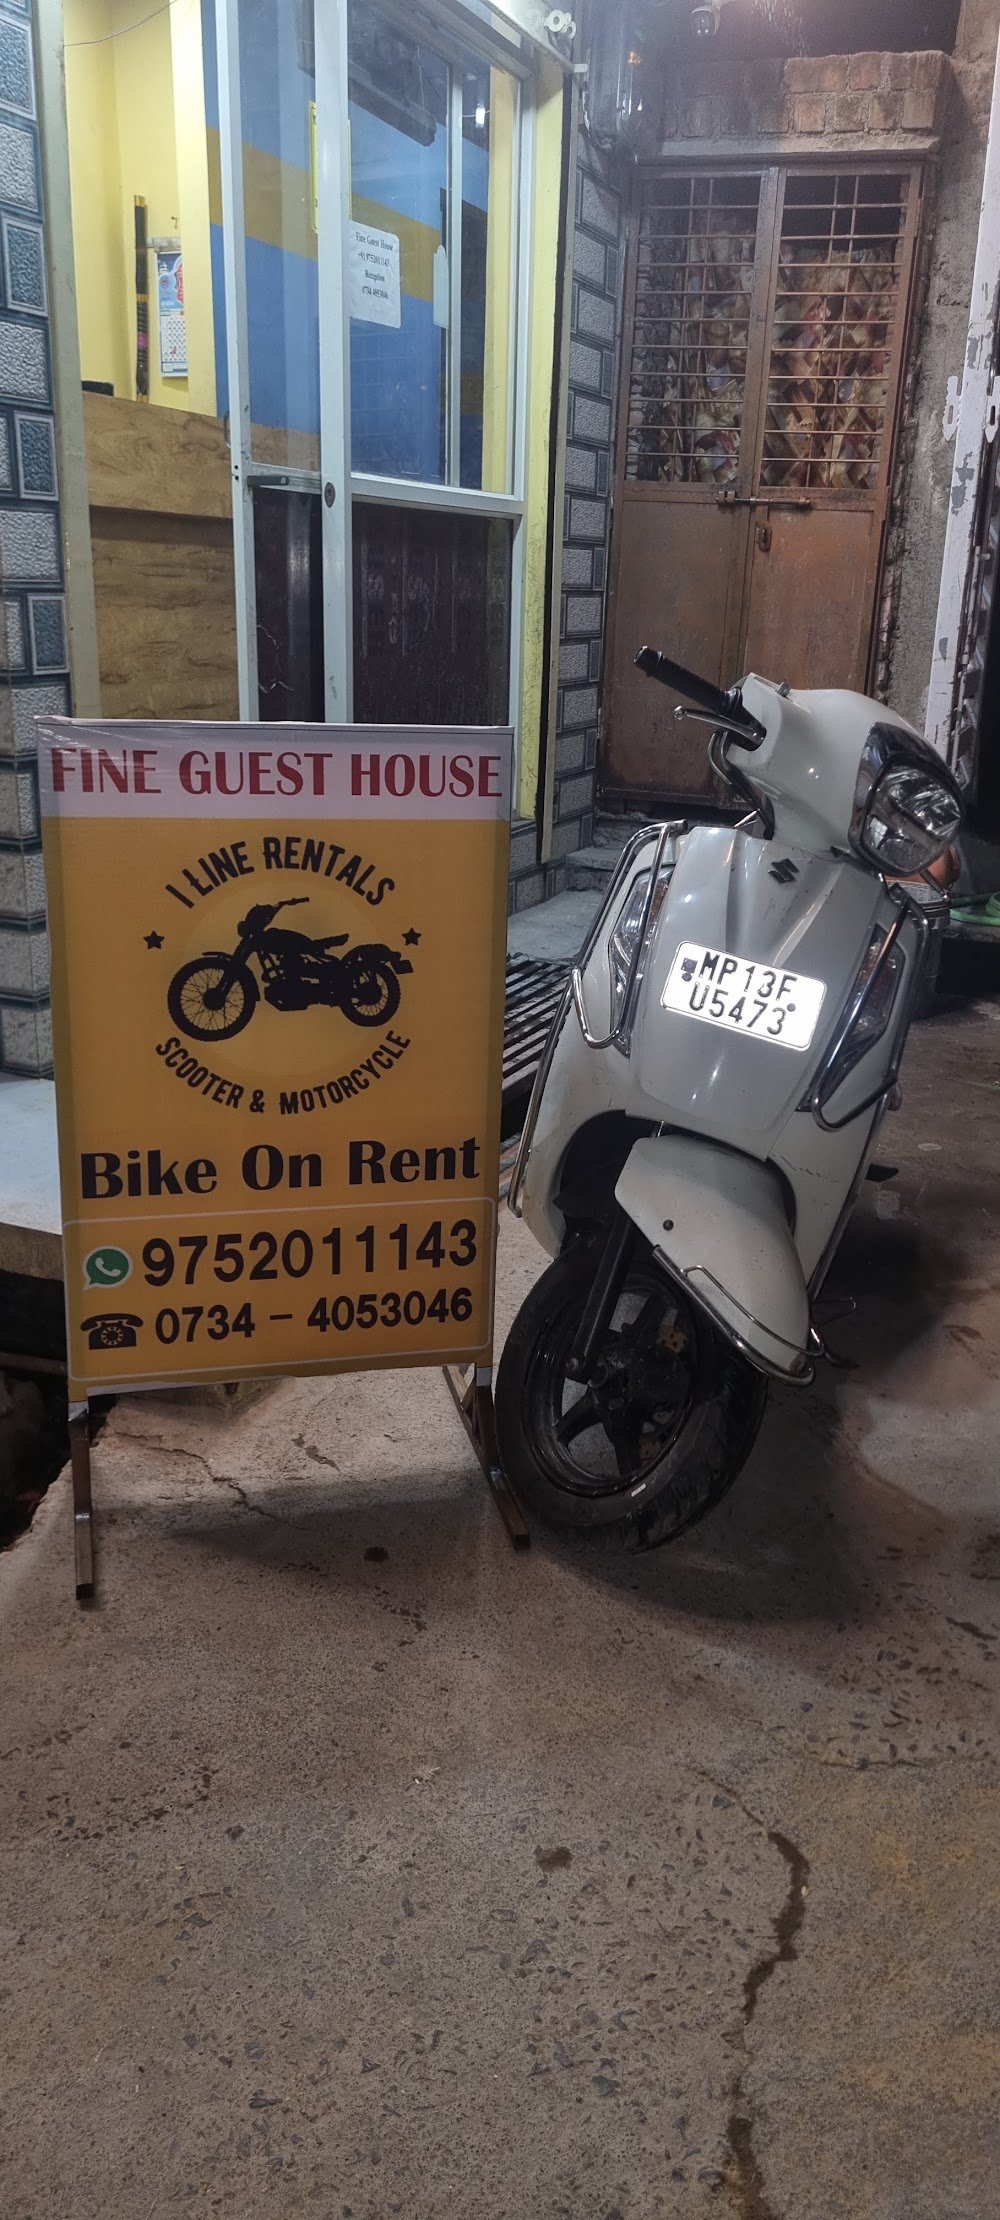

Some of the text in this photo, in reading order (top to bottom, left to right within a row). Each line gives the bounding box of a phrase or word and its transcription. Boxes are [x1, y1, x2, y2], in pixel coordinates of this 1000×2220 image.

[356, 232, 394, 251] Fine Guest House
[365, 269, 385, 283] Reception
[51, 747, 502, 798] FINE GUEST HOUSE
[165, 836, 395, 909] I LINE RENTALS
[689, 982, 787, 1035] U5473
[156, 1030, 411, 1115] SCOOTER & MOTORCYCLE
[80, 1136, 481, 1199] Bike On Rent
[142, 1219, 477, 1287] 9752011143
[155, 1303, 255, 1344] 0734
[307, 1287, 473, 1333] 4053046
